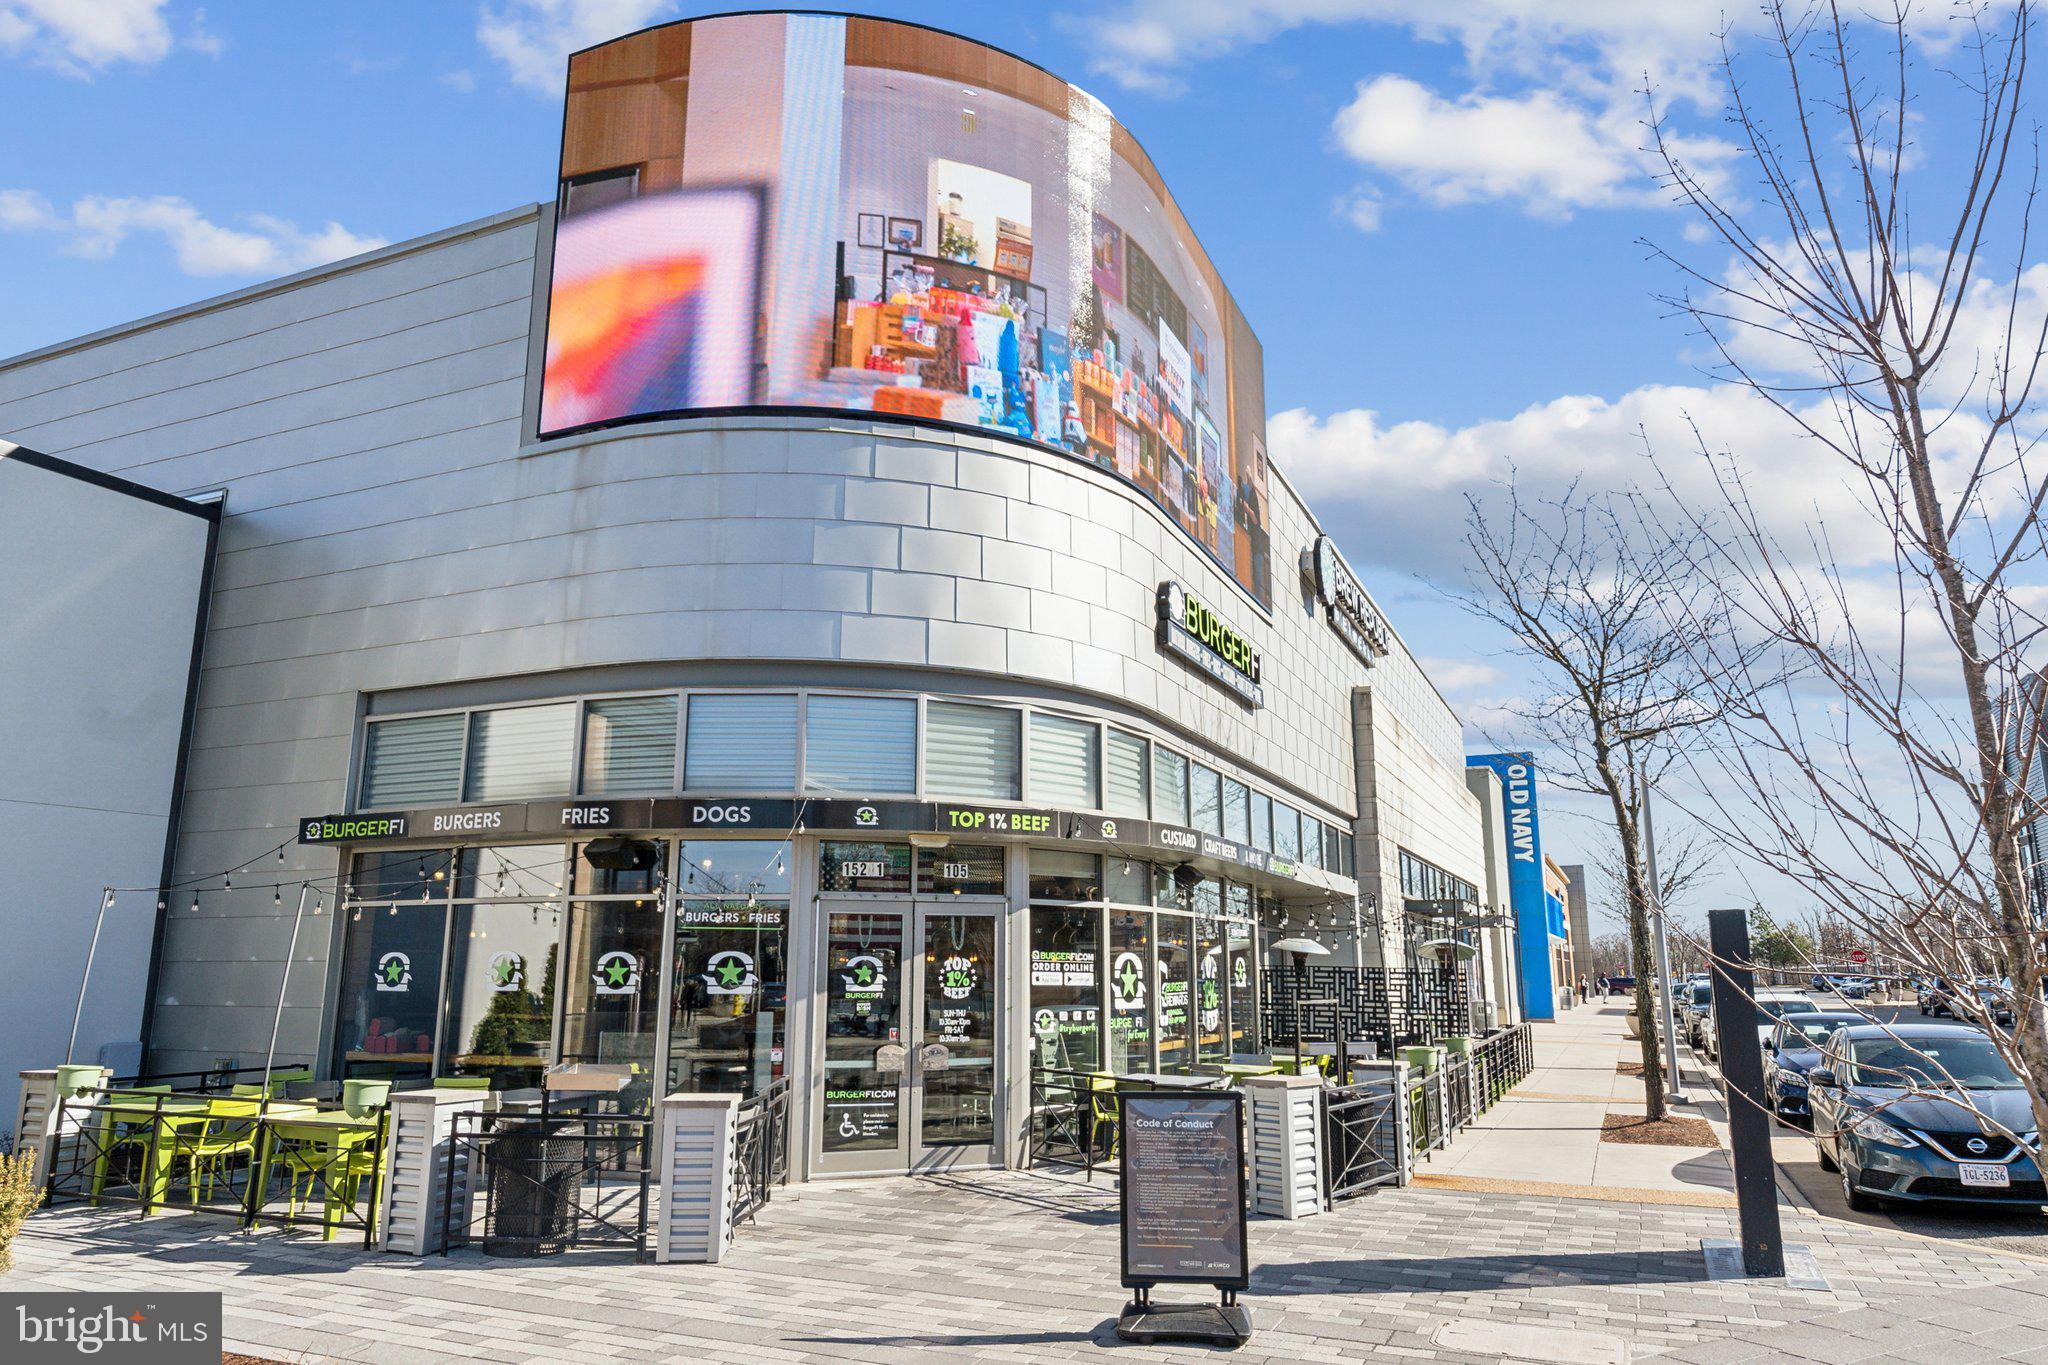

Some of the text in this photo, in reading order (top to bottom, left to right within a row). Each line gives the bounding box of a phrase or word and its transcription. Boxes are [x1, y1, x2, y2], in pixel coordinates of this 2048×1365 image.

[433, 811, 501, 831] BURGERS
[561, 807, 610, 825] FRIES
[693, 806, 751, 823] DOGS
[949, 811, 1051, 832] TOP 1% BEEF
[1507, 764, 1535, 863] OLD NAVY
[323, 819, 404, 839] BURGERFI
[1160, 829, 1197, 849] CUSTARD
[1204, 838, 1222, 856] CRAFT
[1222, 843, 1238, 859] BEERS
[945, 864, 967, 878] 105
[685, 912, 781, 923] BURGERS FRIES
[944, 956, 972, 972] TOP
[1032, 962, 1094, 973] ORDER ONLINE
[946, 971, 970, 987] 1%
[944, 986, 972, 1000] BEEF
[1136, 1119, 1214, 1129] Code of Conduct
[1963, 1170, 2006, 1181] TGL-5236
